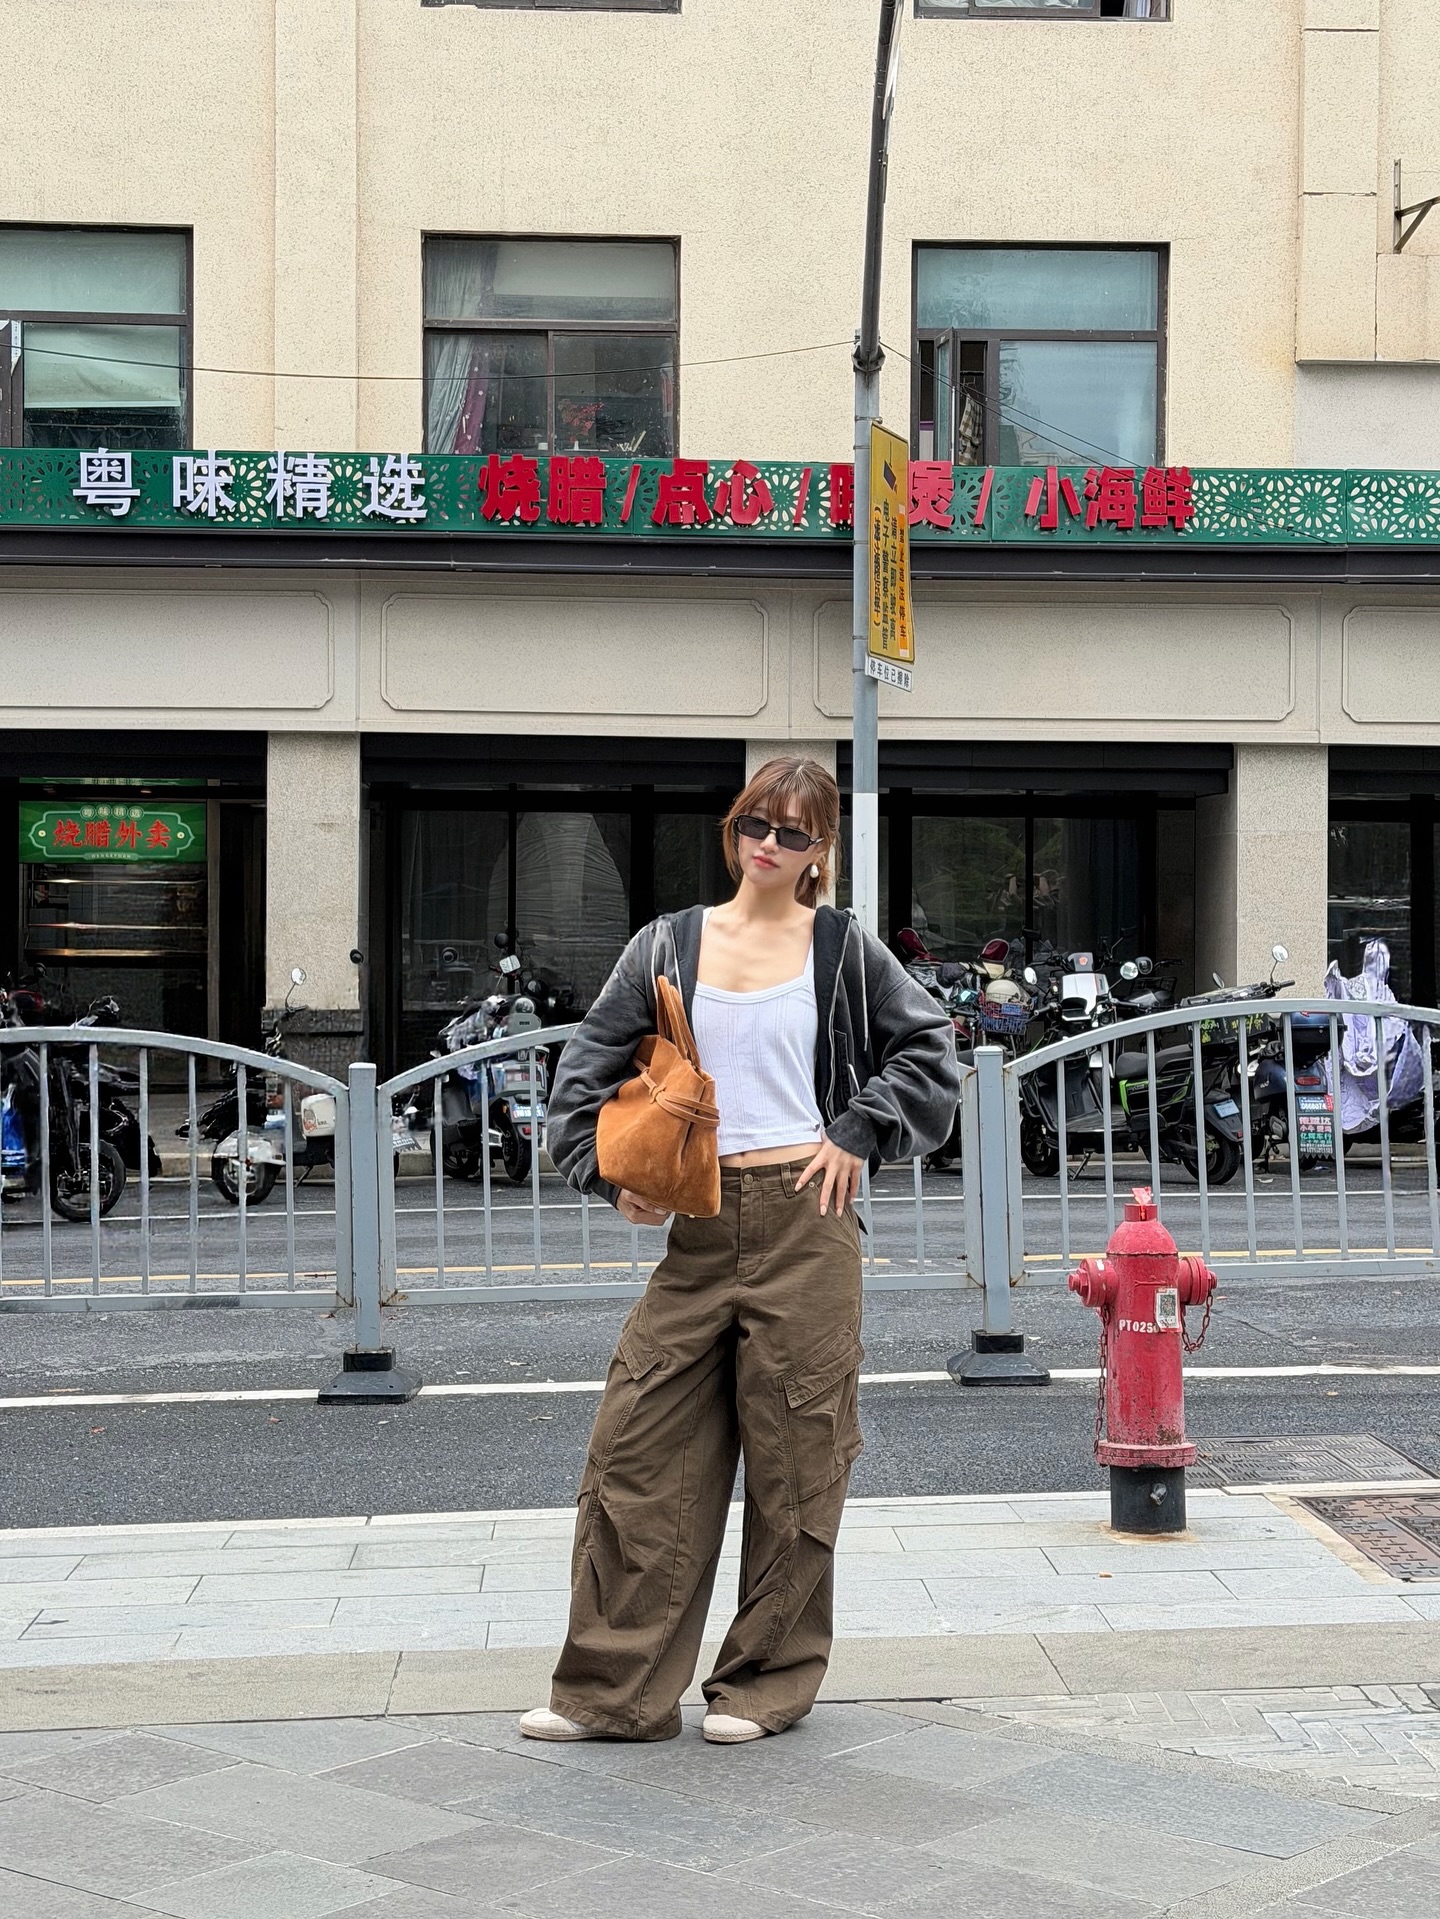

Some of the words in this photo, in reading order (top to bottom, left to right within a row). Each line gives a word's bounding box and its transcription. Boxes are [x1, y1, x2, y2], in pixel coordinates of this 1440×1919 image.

[72, 447, 427, 520] 粤味精选
[53, 818, 172, 849] 烧腊外卖
